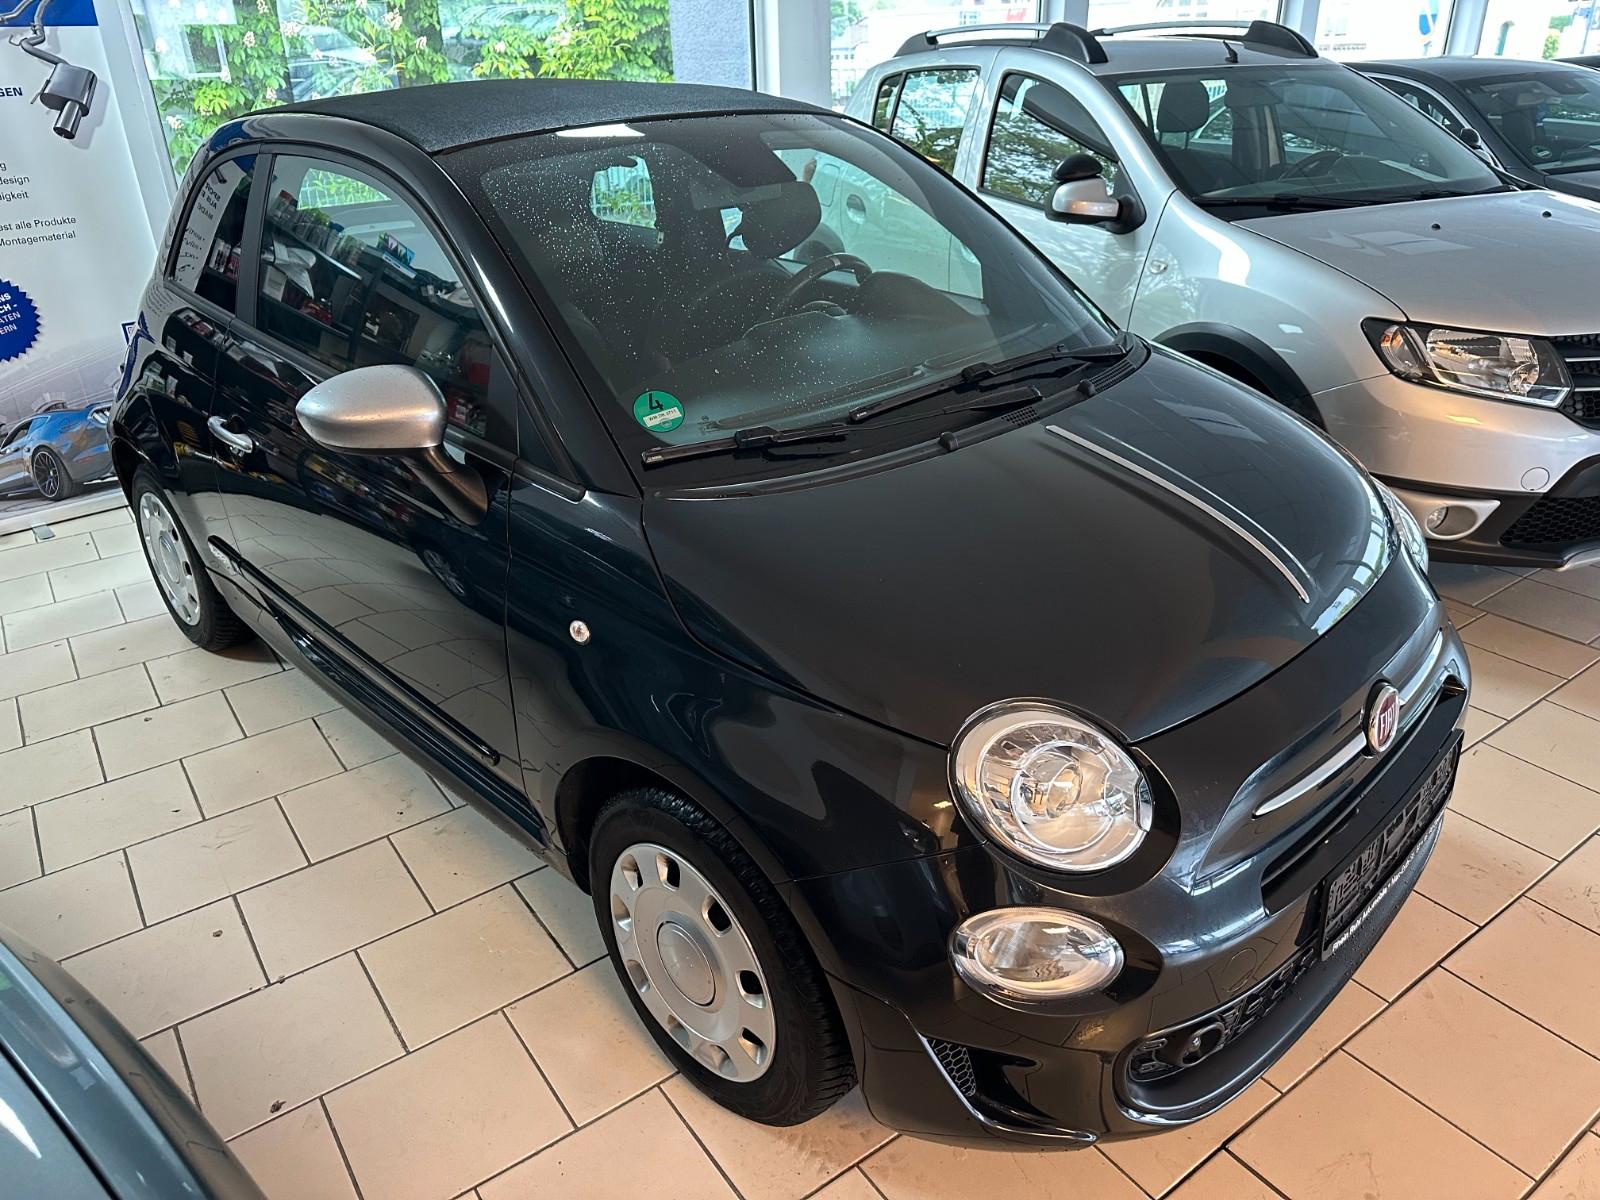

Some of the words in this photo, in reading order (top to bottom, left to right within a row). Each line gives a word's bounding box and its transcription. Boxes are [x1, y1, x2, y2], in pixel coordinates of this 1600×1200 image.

[0, 162, 7, 172] g
[15, 220, 32, 230] alle
[33, 216, 77, 228] Produkte
[648, 392, 664, 411] 4
[1380, 701, 1396, 741] FIAT
